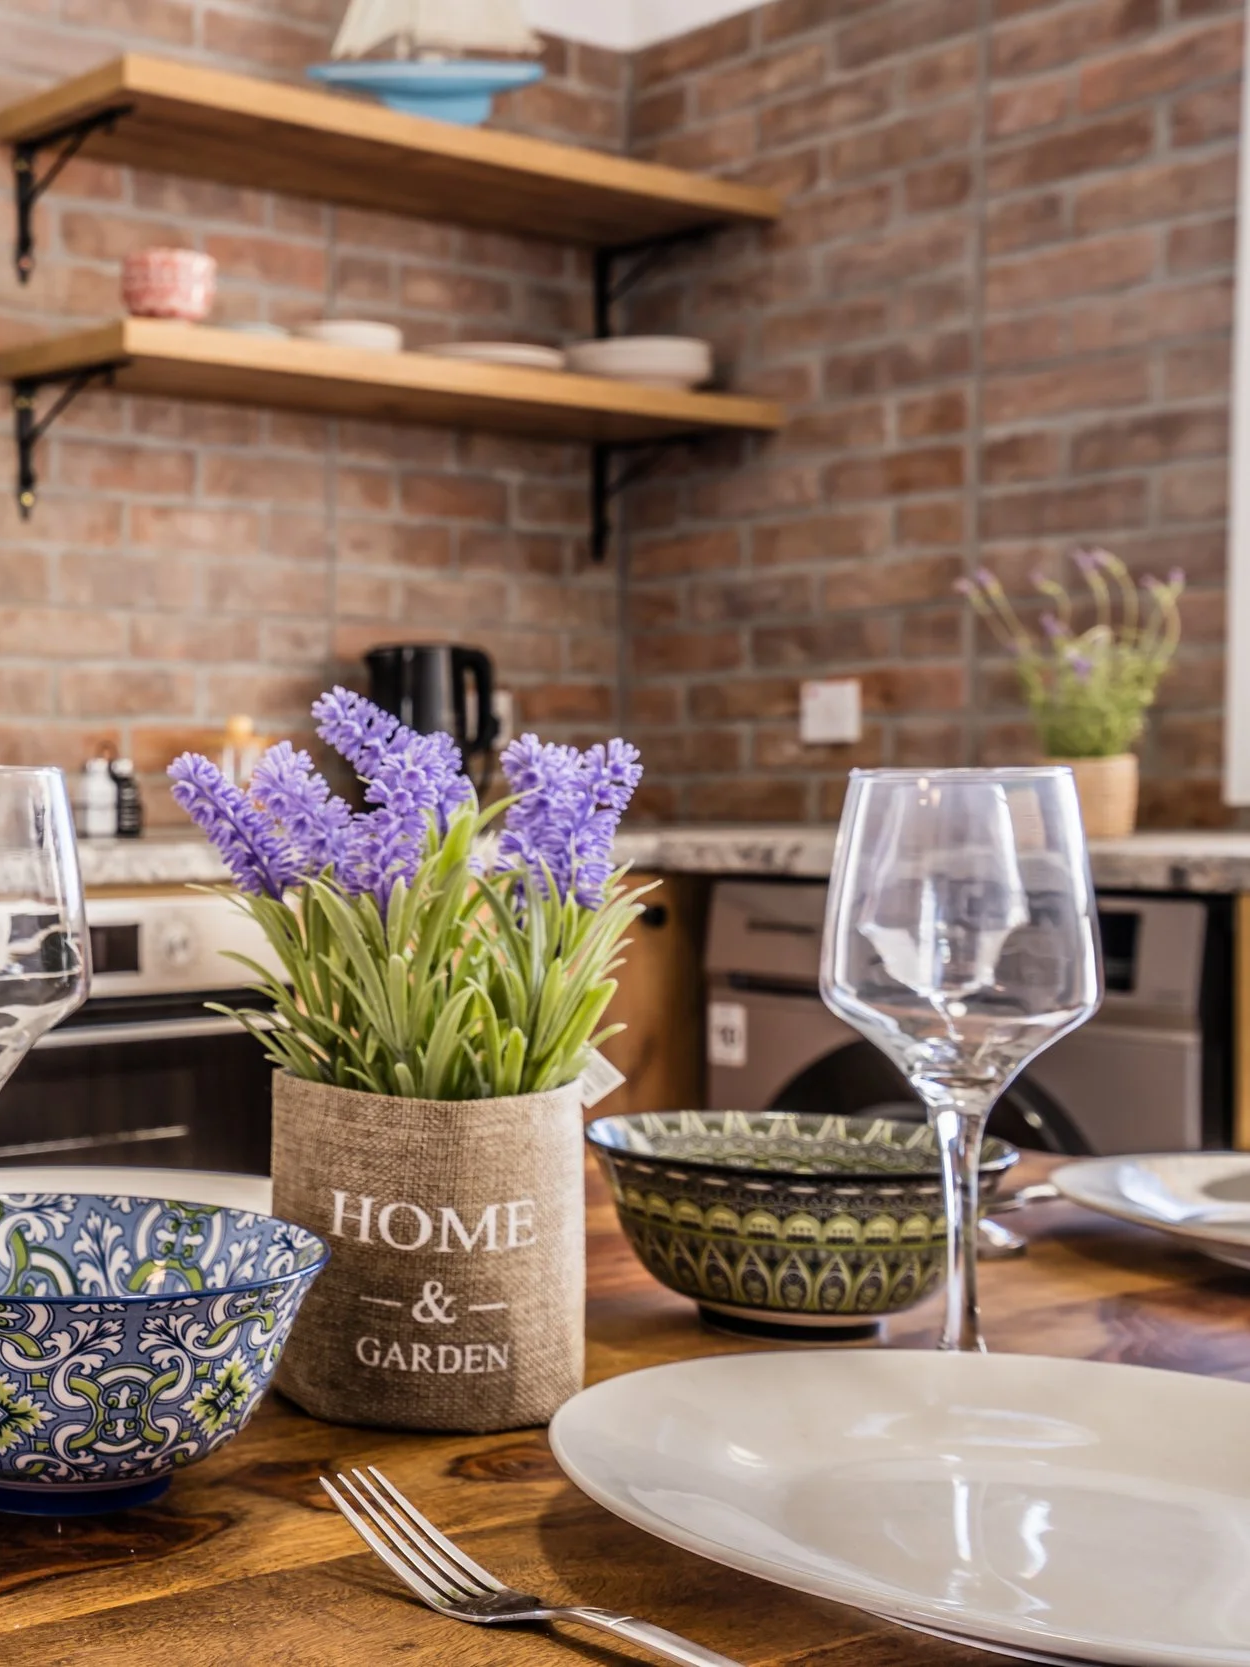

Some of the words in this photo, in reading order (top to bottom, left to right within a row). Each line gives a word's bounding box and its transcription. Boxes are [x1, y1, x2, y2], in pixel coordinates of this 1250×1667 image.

[330, 1190, 537, 1253] HOME
[411, 1280, 457, 1324] &
[355, 1336, 510, 1374] GARDEN
